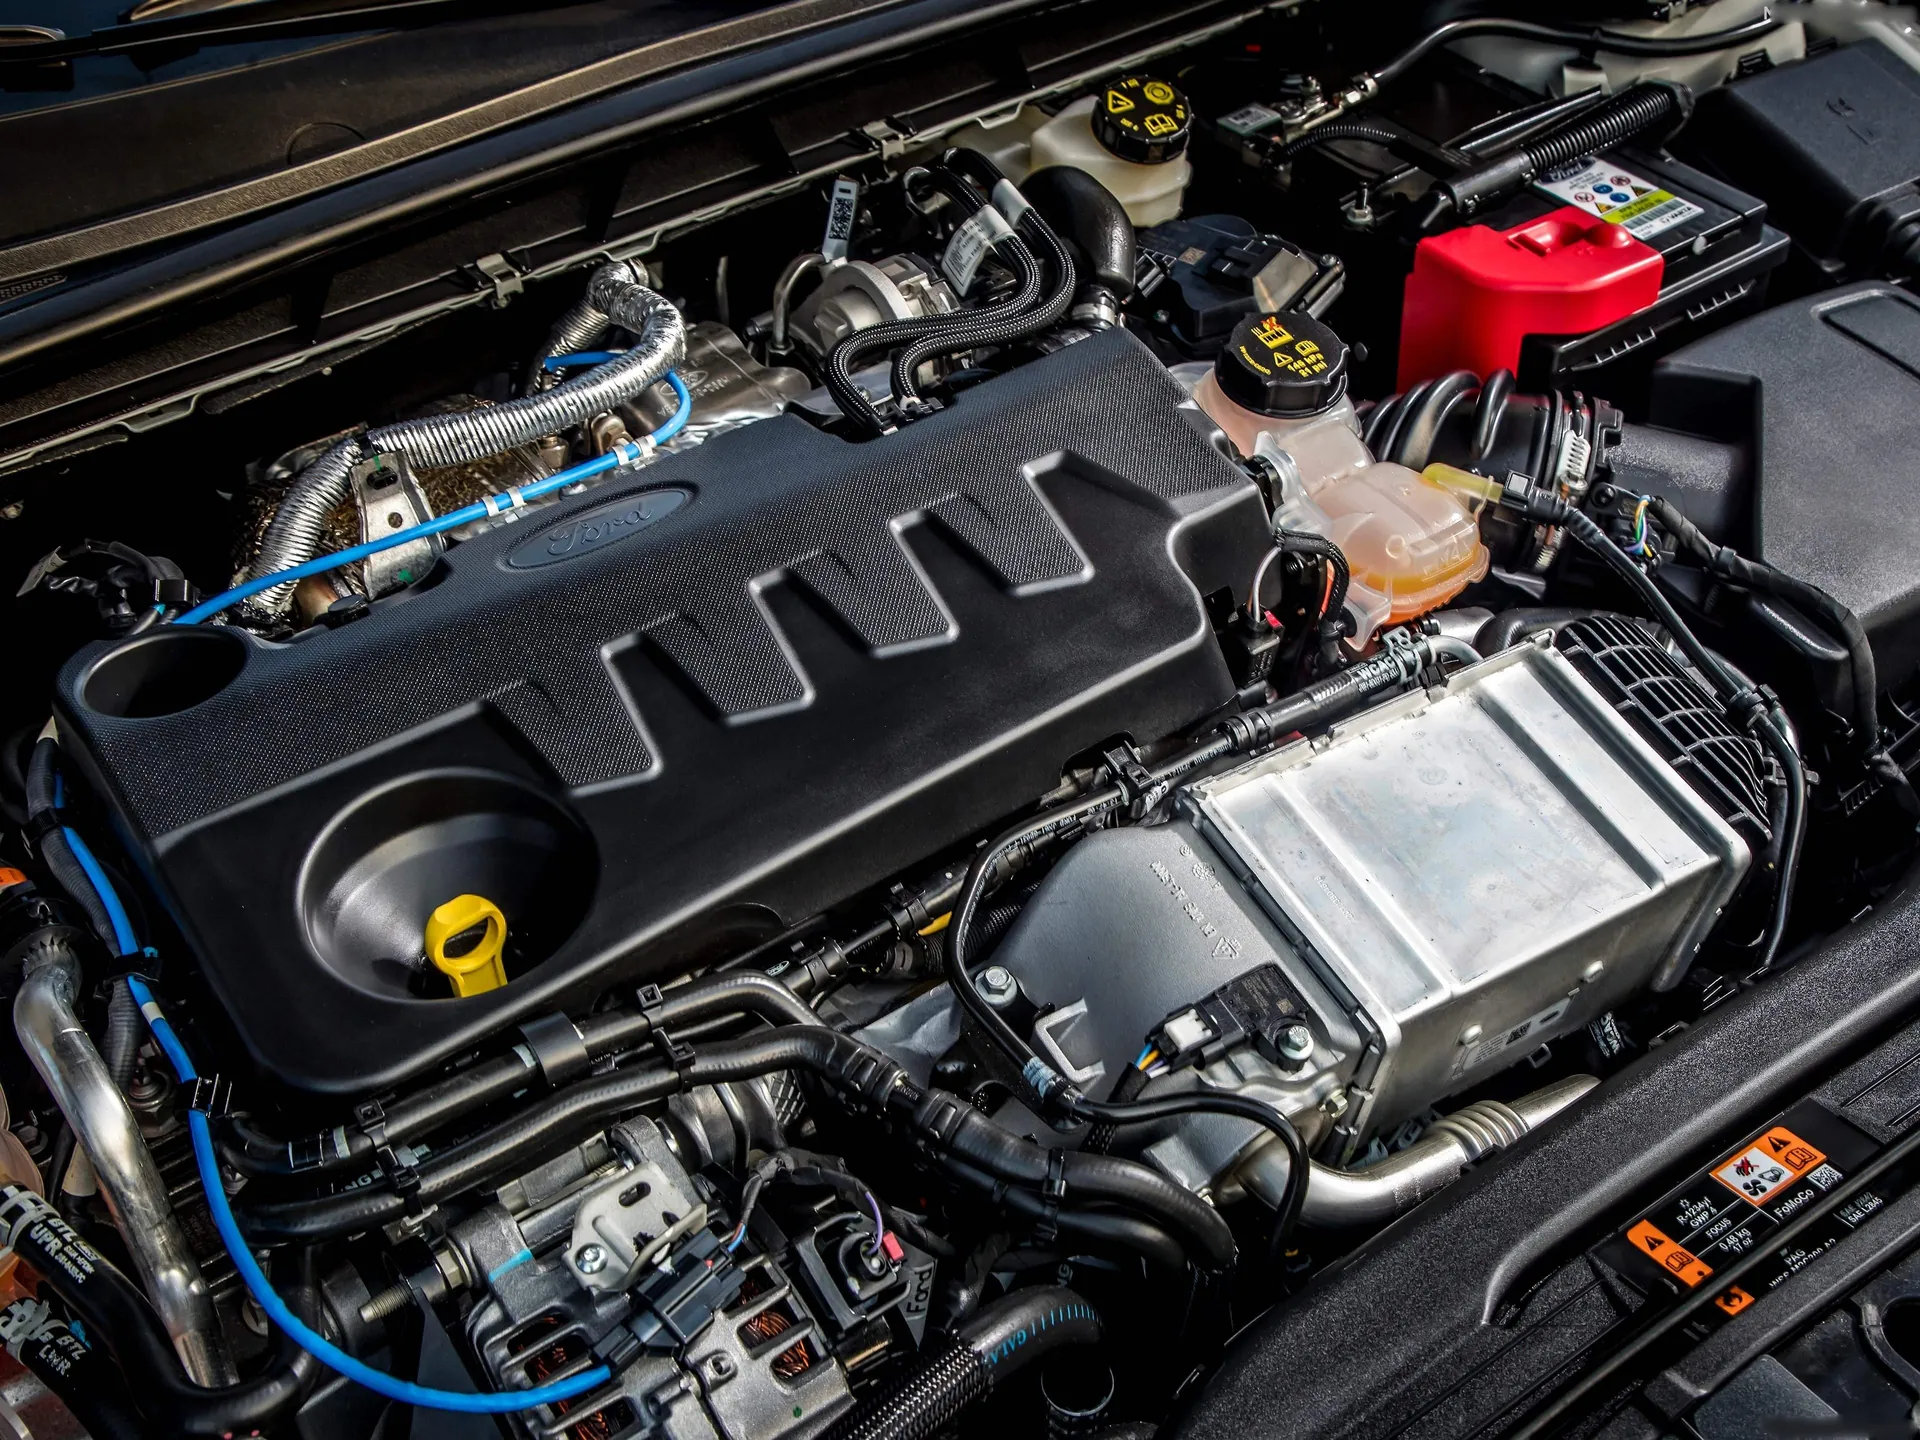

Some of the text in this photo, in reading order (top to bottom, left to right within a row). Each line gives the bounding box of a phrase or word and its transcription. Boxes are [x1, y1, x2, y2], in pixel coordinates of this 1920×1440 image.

[547, 500, 653, 556] Ford
[1357, 655, 1397, 681] WCAC
[1676, 1196, 1713, 1225] R-1234yf
[1773, 1189, 1815, 1219] FoMoCo
[1848, 1209, 1866, 1223] SAE
[47, 1218, 78, 1243] BTL
[1689, 1210, 1710, 1228] GWP
[1705, 1217, 1732, 1239] FOCUS
[30, 1223, 63, 1257] UPR
[1735, 1228, 1751, 1241] kg
[1742, 1237, 1754, 1247] oz
[1784, 1249, 1806, 1266] PAG
[906, 1270, 932, 1314] Ford
